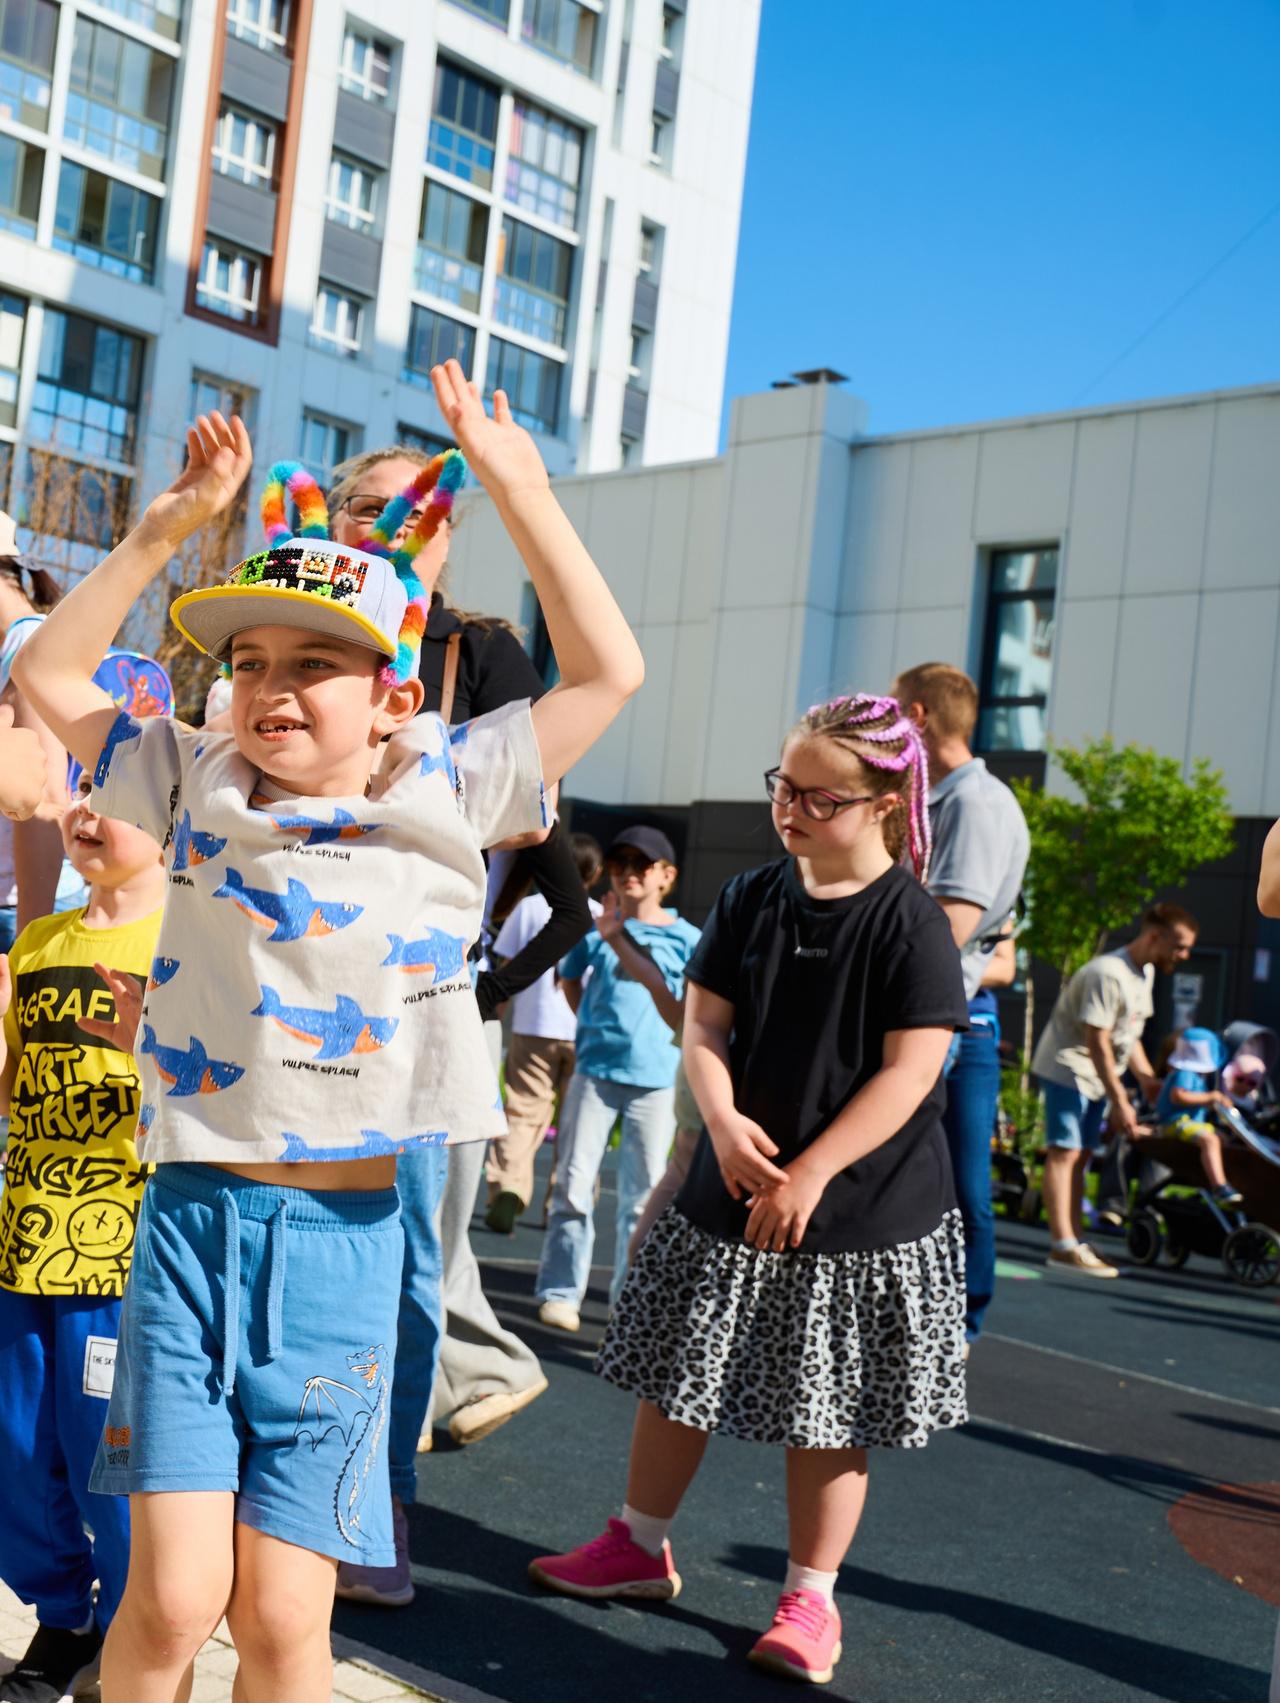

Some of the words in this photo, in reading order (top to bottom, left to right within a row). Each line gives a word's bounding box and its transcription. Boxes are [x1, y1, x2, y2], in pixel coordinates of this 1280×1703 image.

[13, 1046, 87, 1099] ART
[8, 1073, 140, 1146] STREET
[92, 1355, 103, 1365] THE
